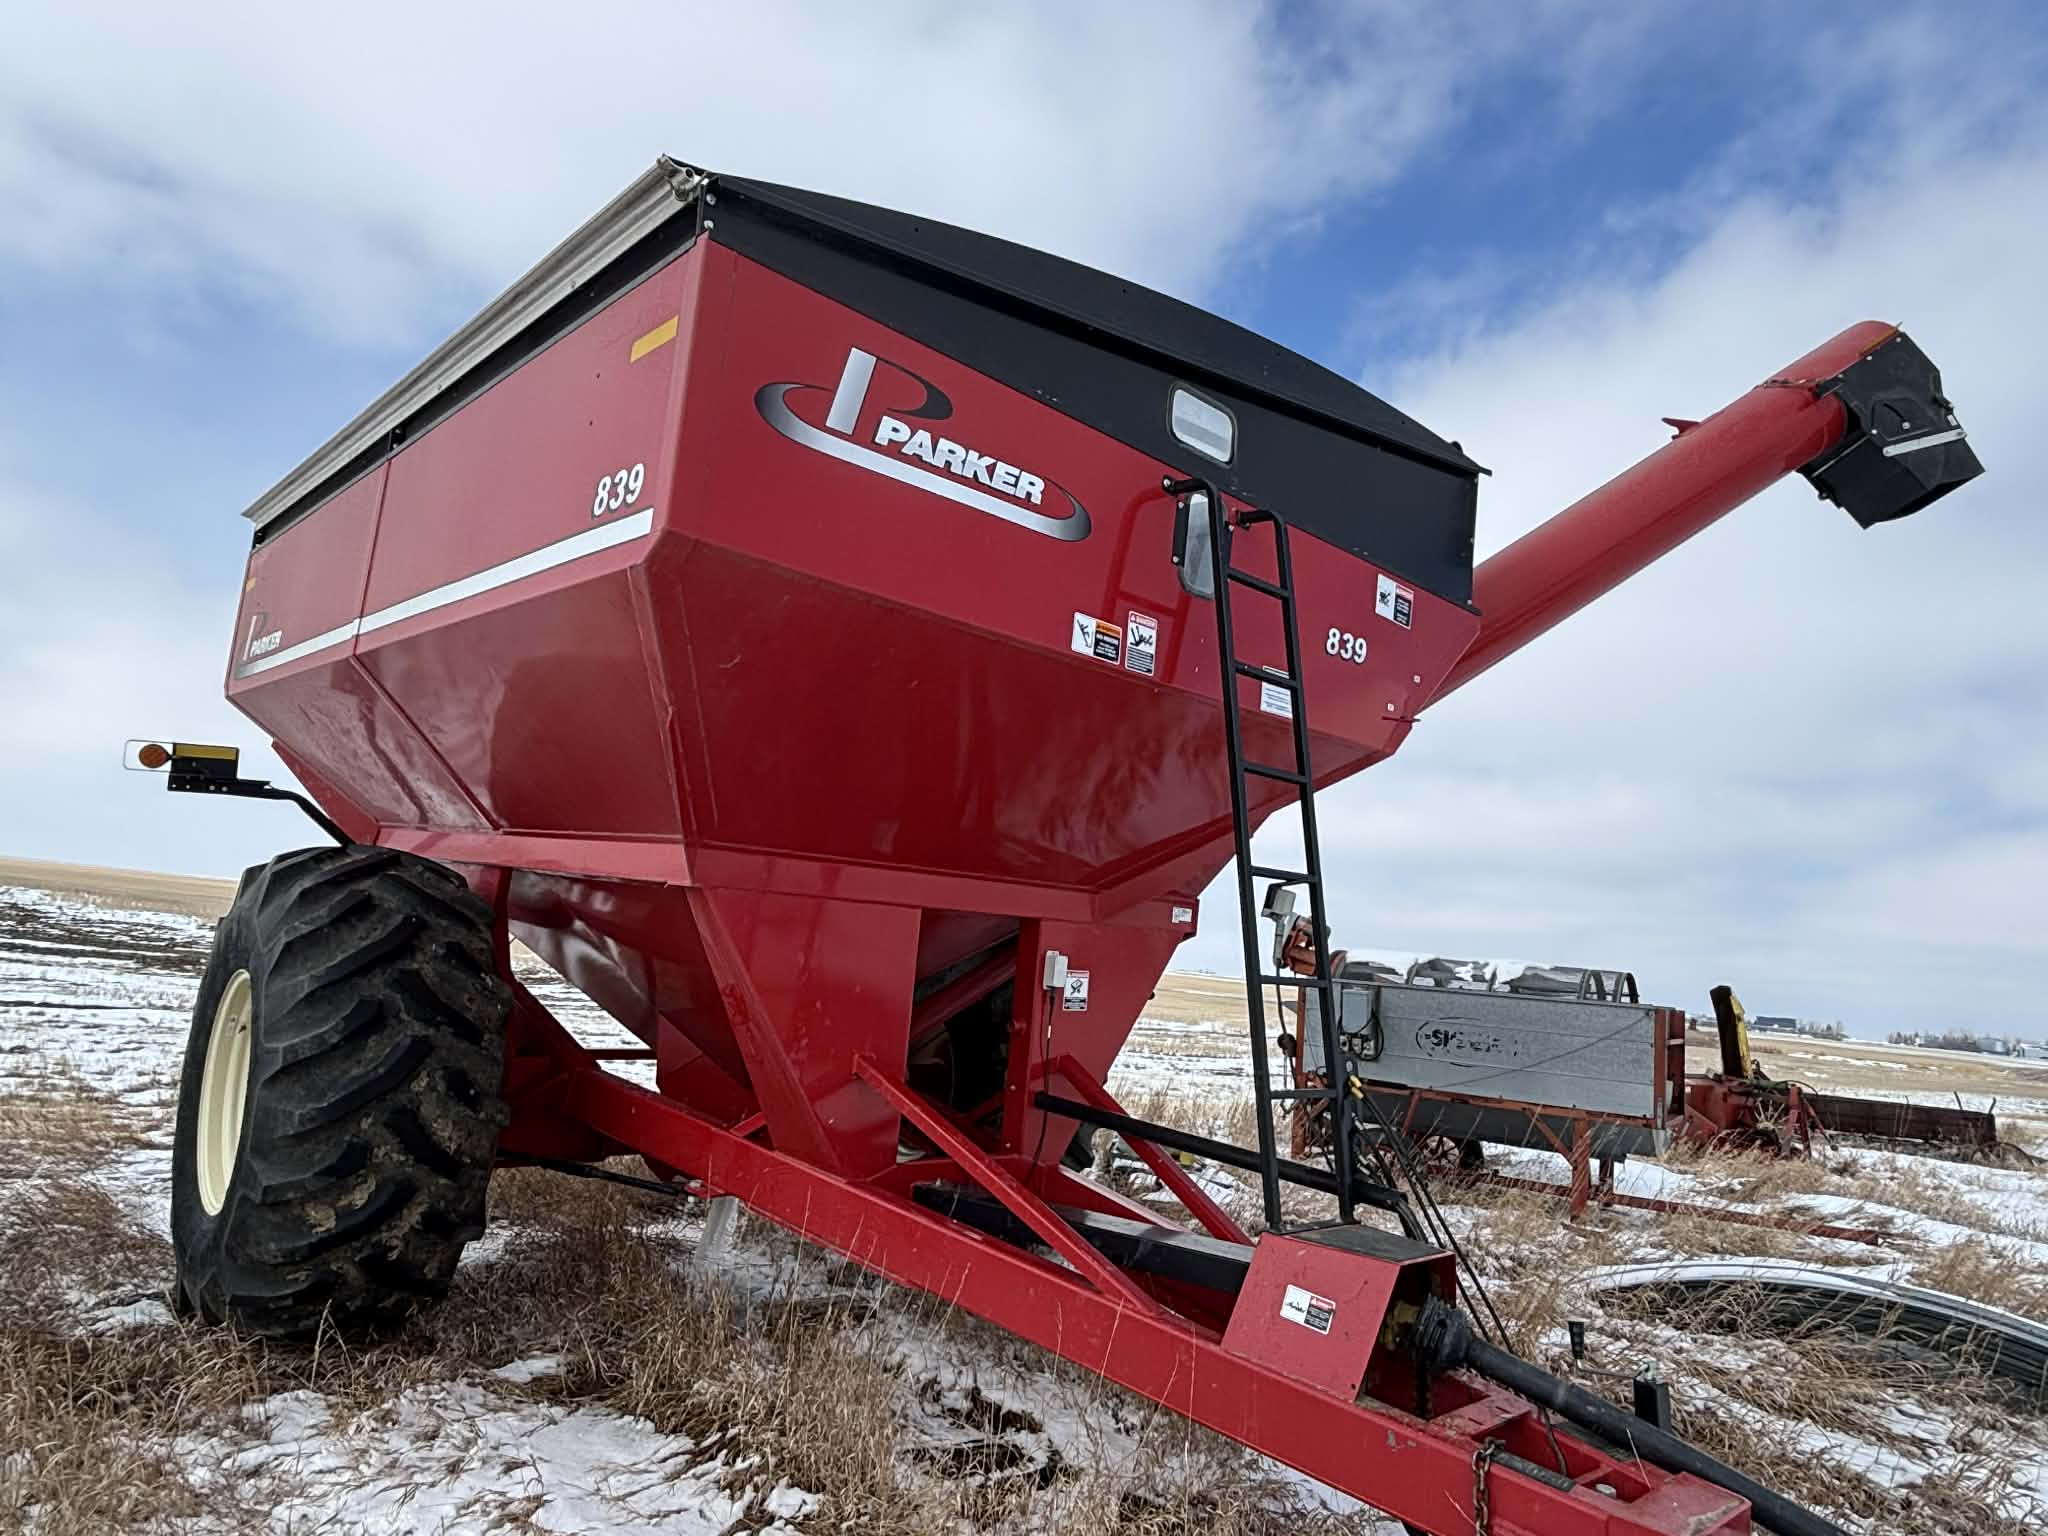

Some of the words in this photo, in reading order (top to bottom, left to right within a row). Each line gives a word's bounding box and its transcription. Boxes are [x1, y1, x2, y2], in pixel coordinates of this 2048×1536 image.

[873, 415, 1046, 505] PARKER
[592, 463, 645, 517] 839
[1326, 627, 1367, 664] 839
